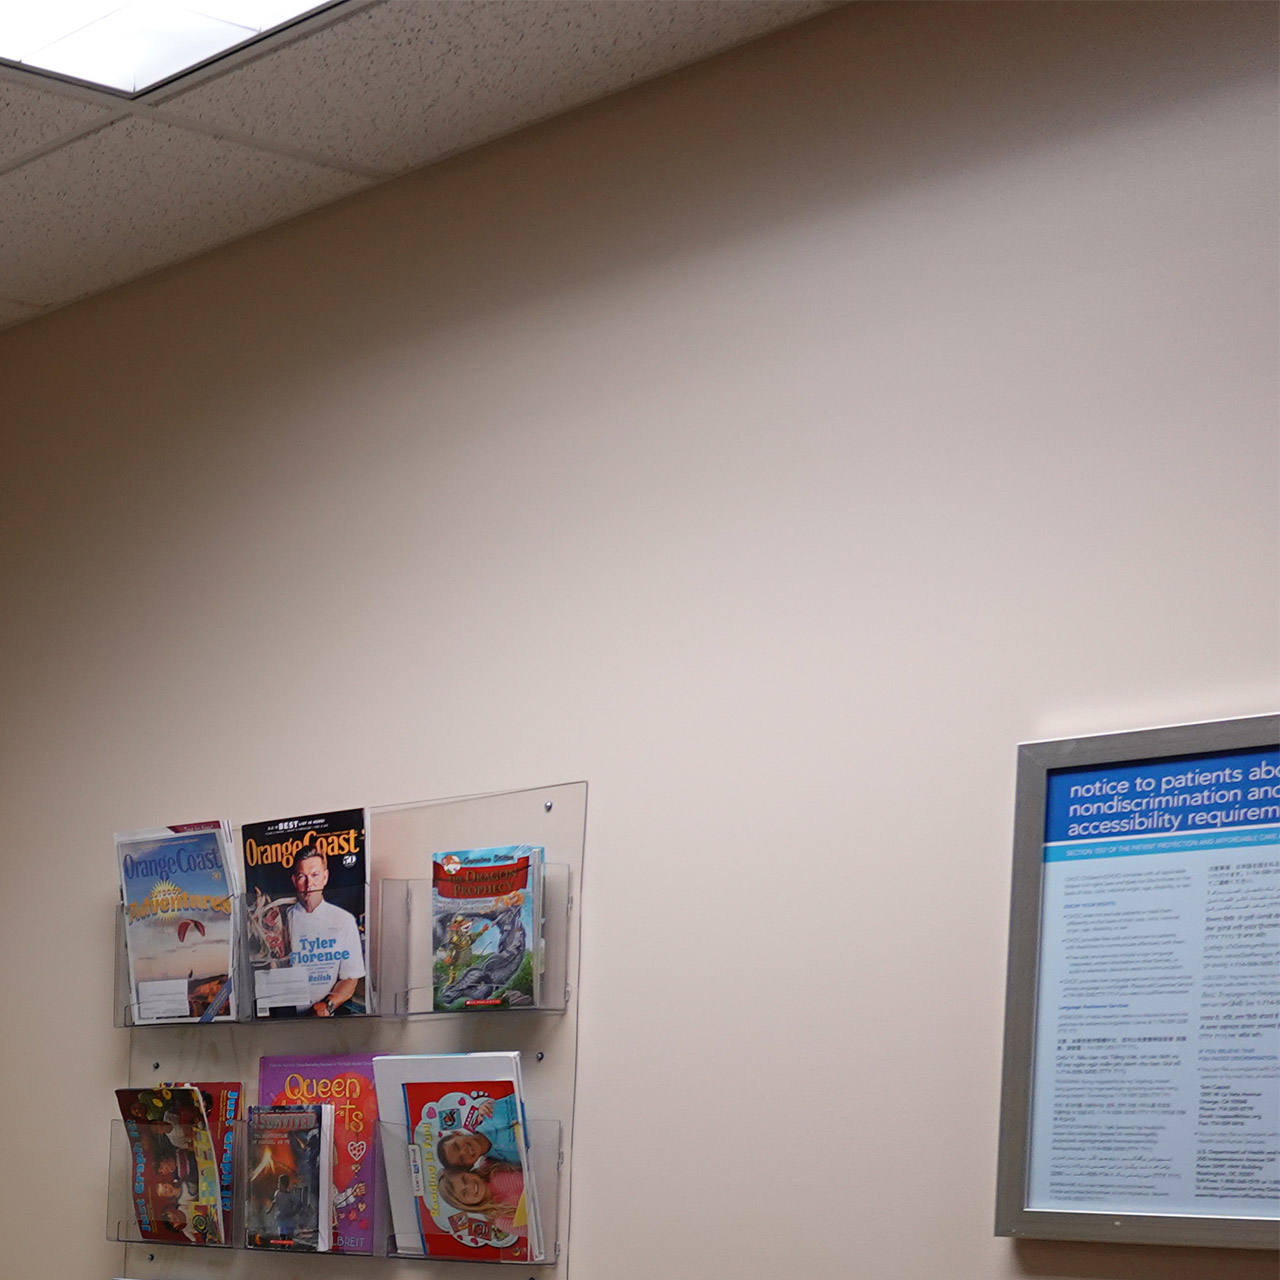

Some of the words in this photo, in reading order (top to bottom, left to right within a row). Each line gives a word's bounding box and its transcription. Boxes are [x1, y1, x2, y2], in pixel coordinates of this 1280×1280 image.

[1069, 778, 1130, 798] notice
[1135, 777, 1156, 792] to
[1160, 767, 1243, 795] patients
[1068, 786, 1241, 818] nondiscrimination
[1067, 810, 1183, 837] accessibility
[123, 854, 177, 881] Orange
[176, 848, 223, 873] Coast
[246, 837, 303, 869] Orange
[342, 854, 357, 866] 50
[453, 880, 514, 897] PROPHECY
[465, 868, 518, 883] DRAGON
[289, 950, 350, 965] Florence
[299, 937, 337, 953] Tyler
[308, 974, 332, 983] Relish
[284, 1073, 361, 1101] Queen
[226, 1090, 238, 1127] Just
[422, 1122, 433, 1148] Fun!
[133, 1142, 146, 1194] Graph
[221, 1131, 234, 1187] Graph
[428, 1165, 440, 1217] Reading
[135, 1198, 151, 1232] Just
[333, 1236, 365, 1247] BREIT
